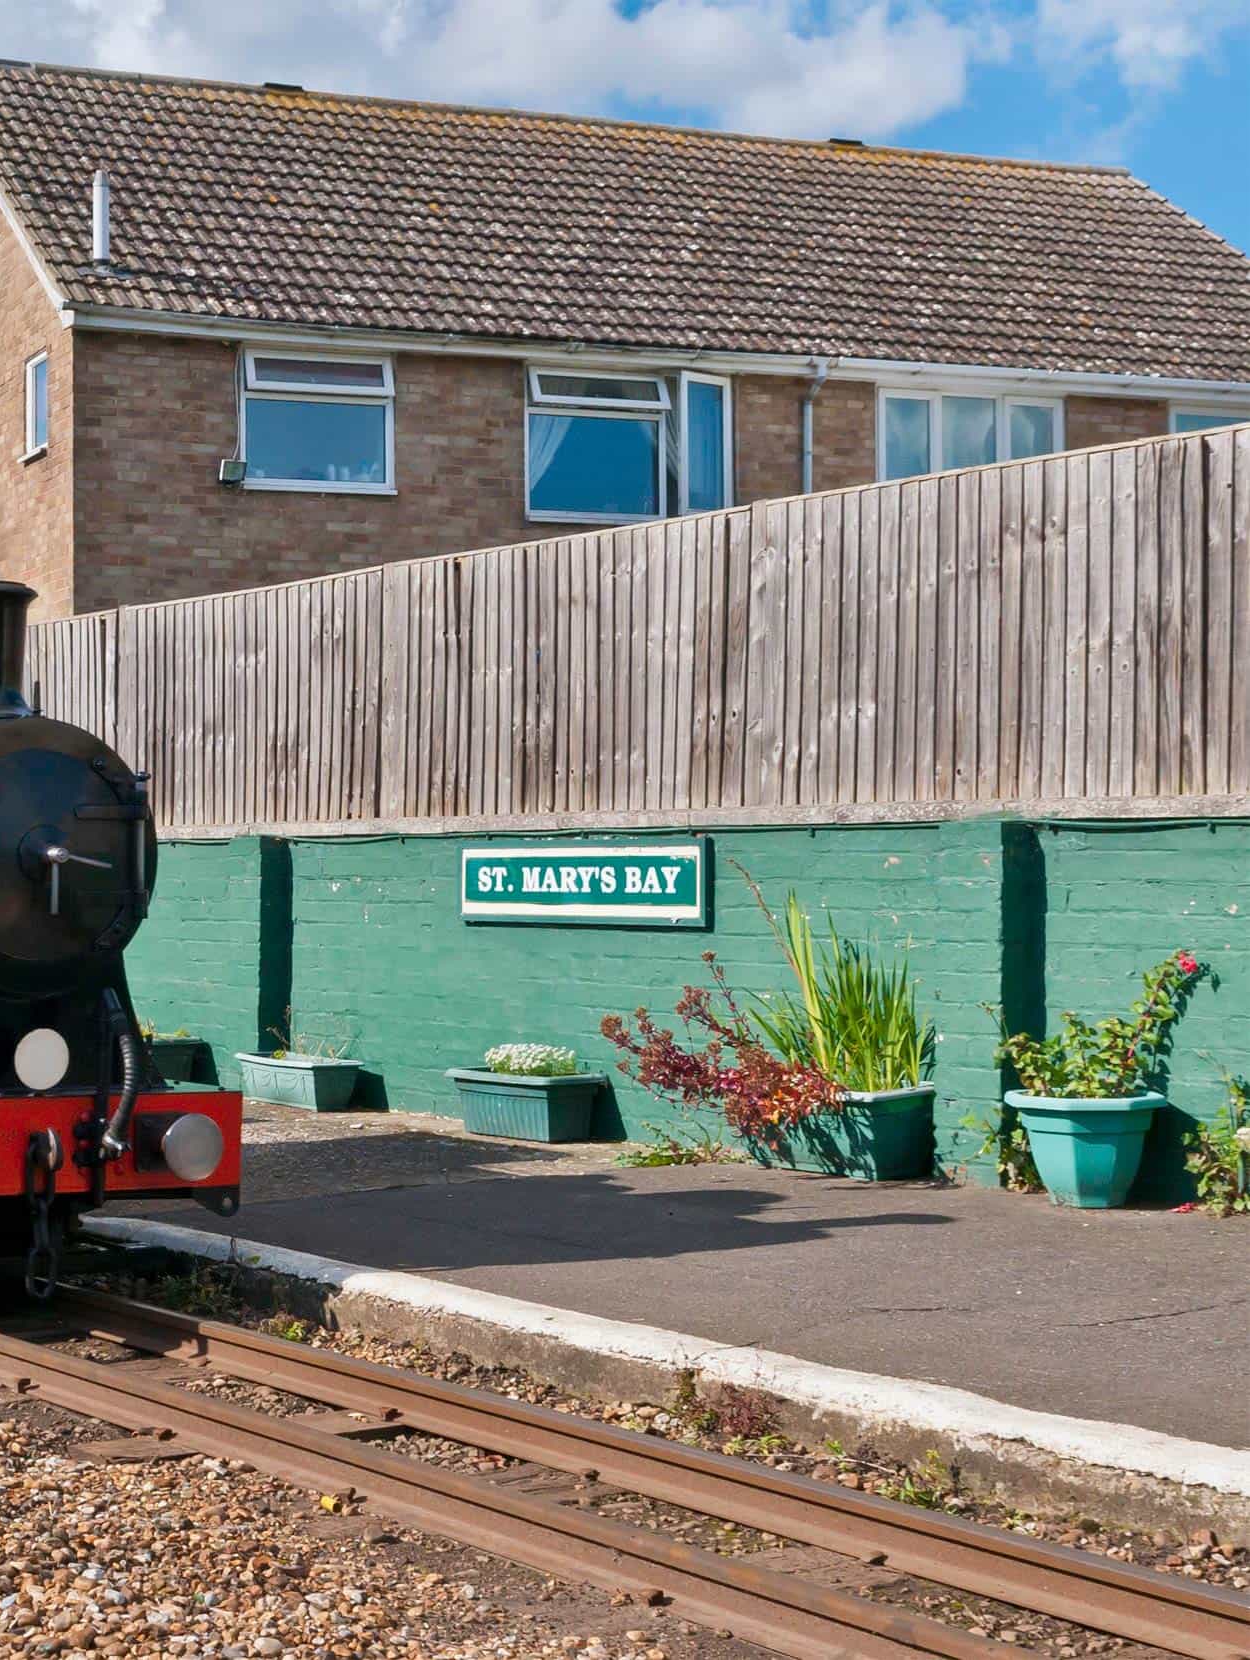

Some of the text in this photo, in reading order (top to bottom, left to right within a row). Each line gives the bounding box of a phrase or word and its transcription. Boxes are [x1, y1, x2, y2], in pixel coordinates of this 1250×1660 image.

[477, 866, 681, 894] ST. MARY'S BAY
